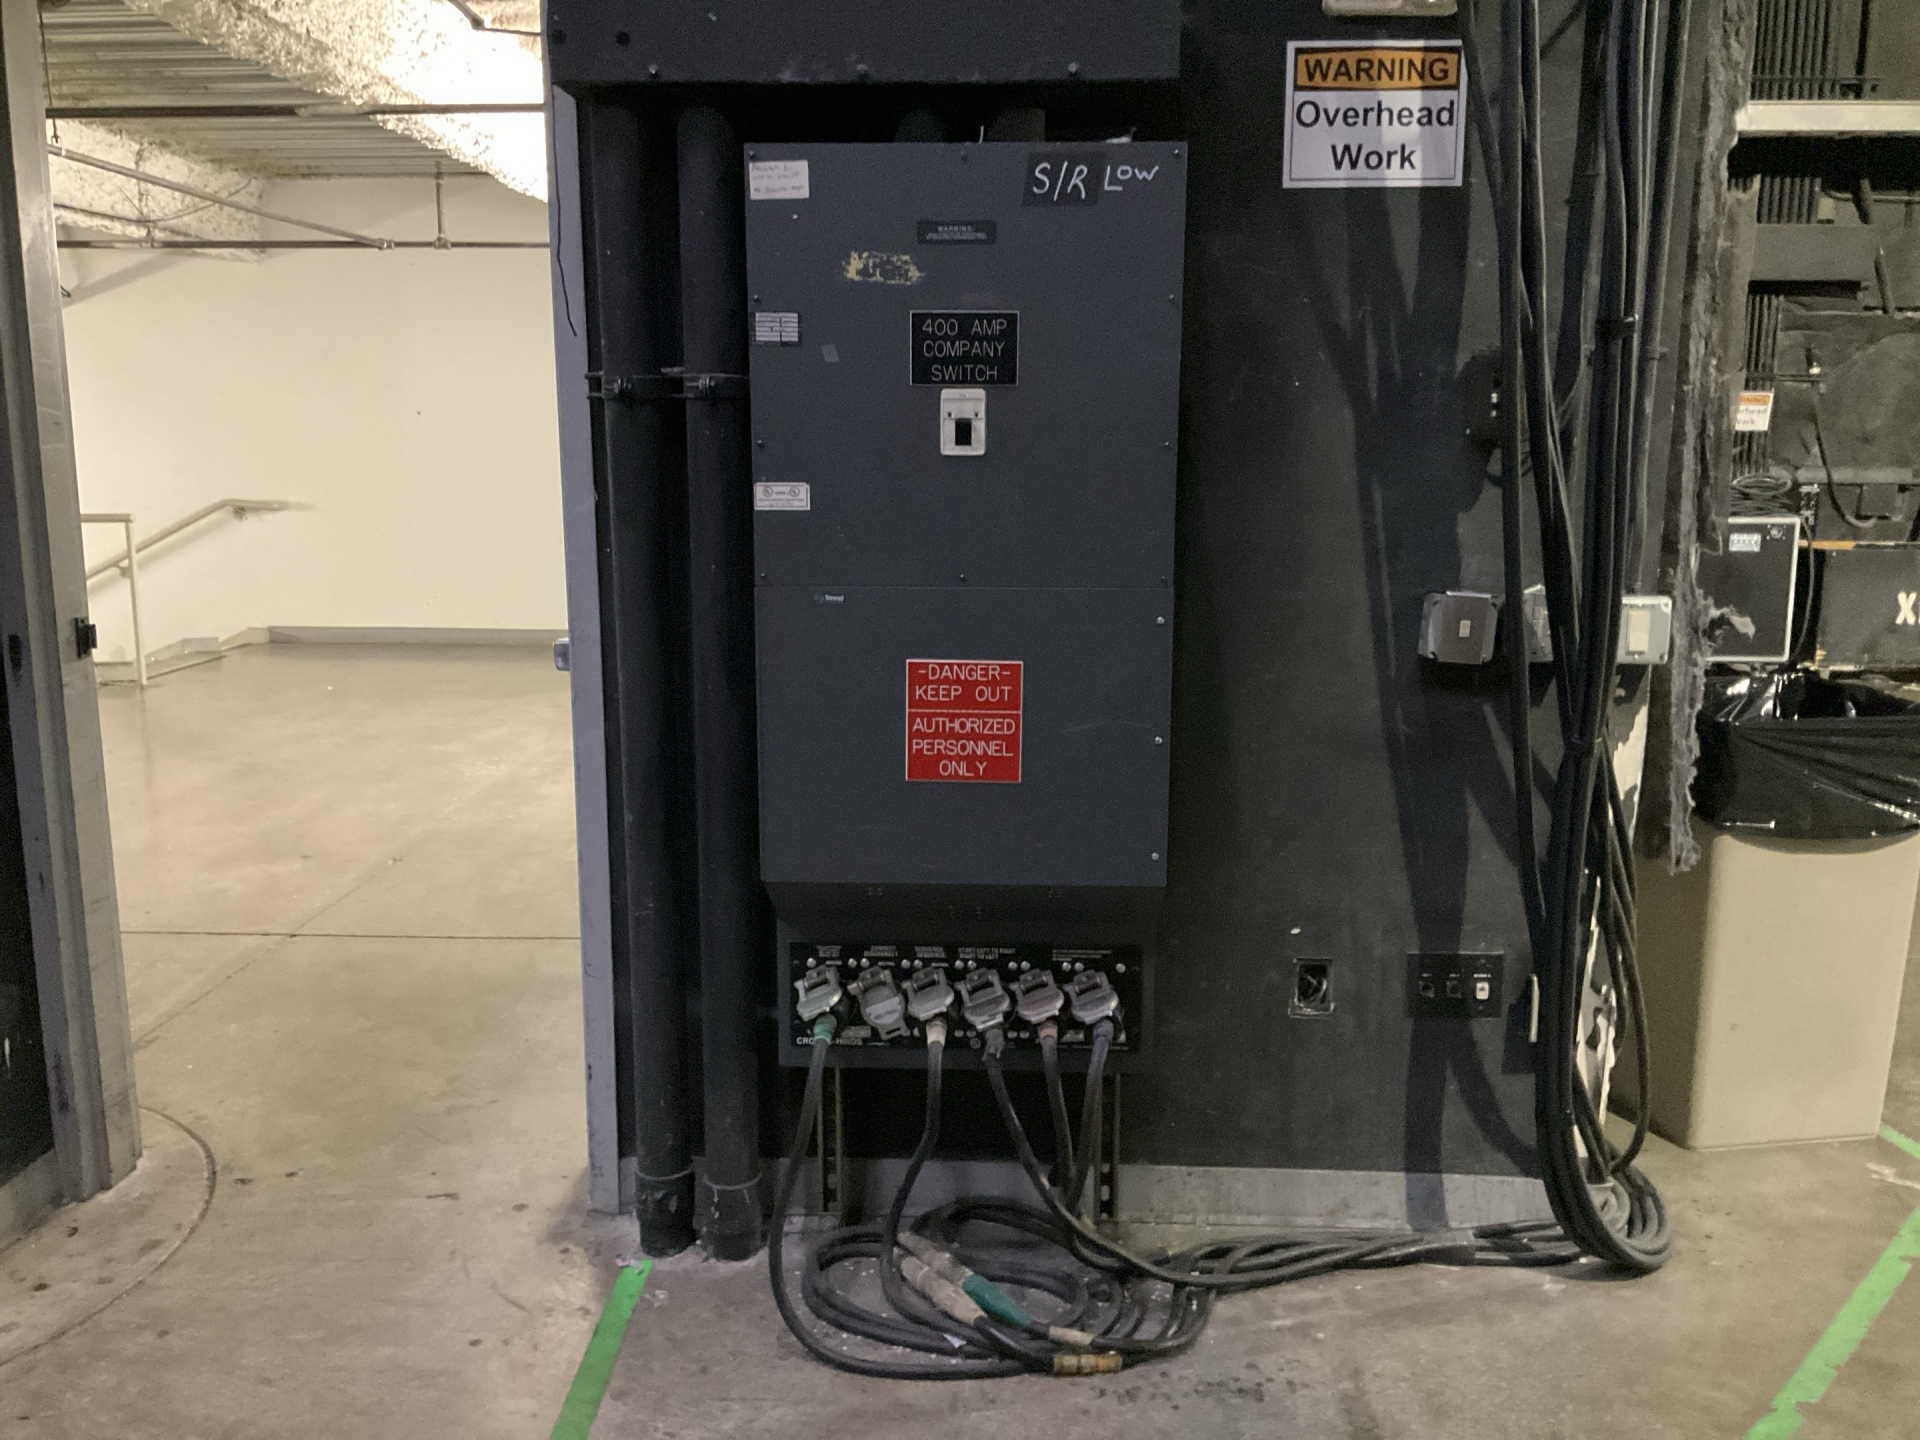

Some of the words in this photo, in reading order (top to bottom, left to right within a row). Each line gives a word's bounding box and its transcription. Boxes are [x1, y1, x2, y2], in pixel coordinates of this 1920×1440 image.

[1304, 57, 1449, 82] WARNING
[1295, 99, 1455, 128] Overhead
[1330, 143, 1417, 171] Work
[1032, 160, 1088, 202] S/R
[922, 318, 958, 336] 400
[971, 318, 1007, 336] AMP
[923, 340, 1006, 358] COMPANY
[931, 364, 998, 382] SWITCH
[918, 663, 1011, 681] -DANGER-
[915, 685, 962, 701] KEEP
[975, 685, 1012, 702] OUT
[912, 717, 1016, 735] AUTHORIZED
[912, 738, 1014, 757] PERSONNEL
[939, 759, 987, 776] ONLY
